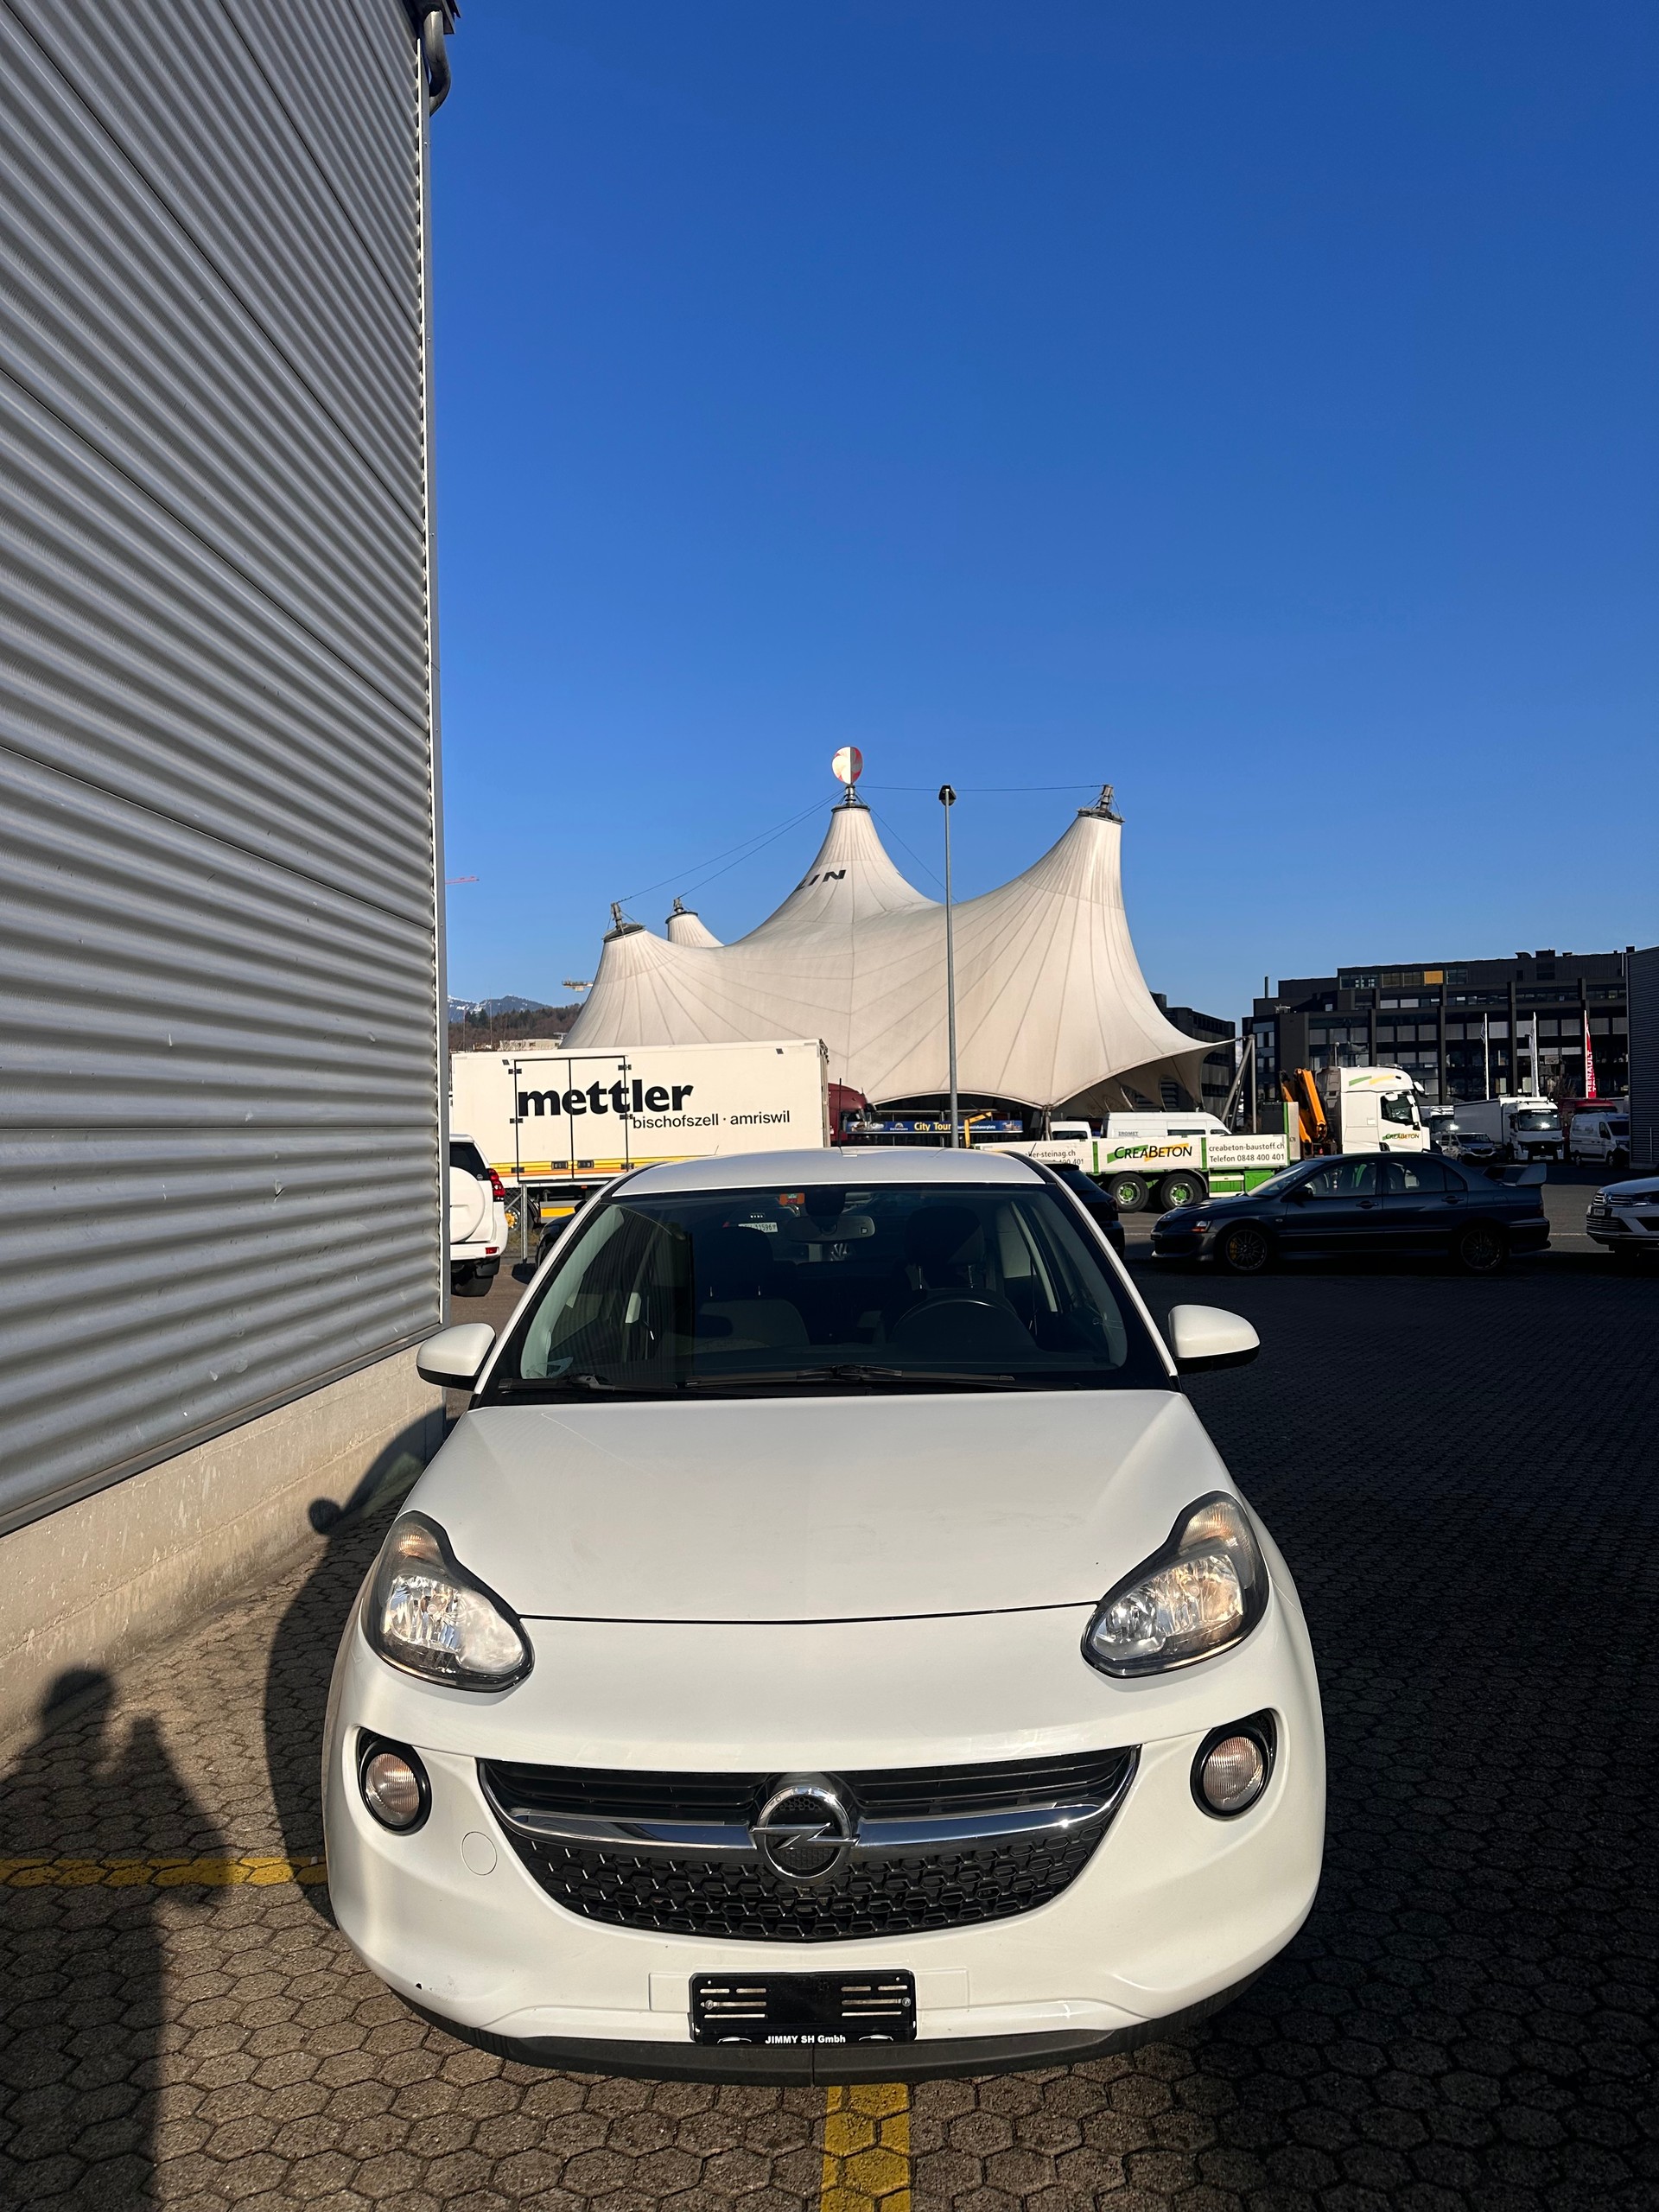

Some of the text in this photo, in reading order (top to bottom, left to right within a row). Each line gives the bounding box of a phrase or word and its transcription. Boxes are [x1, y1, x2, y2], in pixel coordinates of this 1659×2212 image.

[518, 1079, 694, 1117] mettler
[632, 1110, 791, 1128] bischofszell amriswil
[913, 1122, 931, 1131] City
[933, 1122, 951, 1131] Tour
[1209, 1142, 1285, 1152] creabeton-baustoff.ch
[1210, 1154, 1235, 1163] Telefon
[1237, 1154, 1255, 1162] 0848
[765, 2034, 846, 2044] JIMMY SH Gmbh
